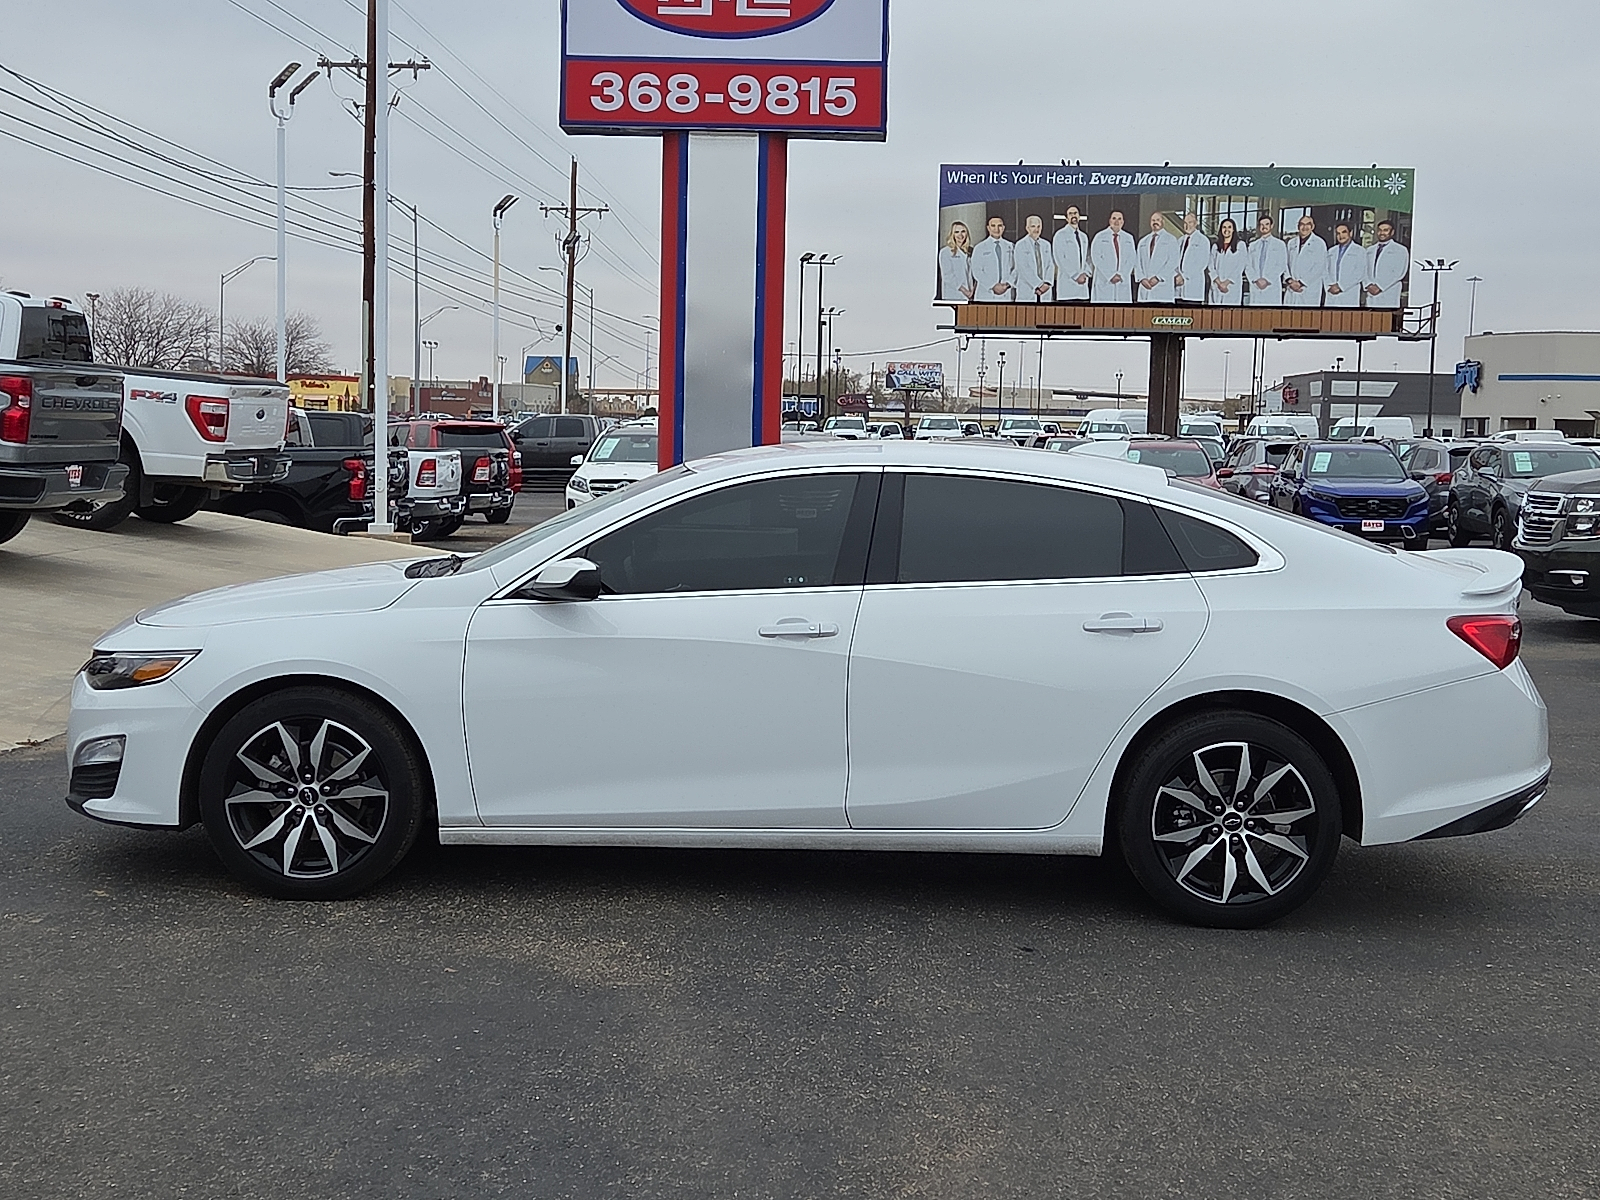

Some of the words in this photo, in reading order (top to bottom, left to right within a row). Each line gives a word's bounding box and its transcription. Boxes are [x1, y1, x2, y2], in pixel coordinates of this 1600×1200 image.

[590, 71, 858, 117] 368-9815
[947, 170, 986, 184] When
[989, 170, 1008, 184] It's
[1011, 171, 1043, 185] Your
[1046, 171, 1087, 187] Heart,
[1088, 172, 1132, 188] Every
[1132, 172, 1194, 186] Moment
[1194, 173, 1254, 187] Matters.
[1280, 174, 1381, 189] CovenantHealth
[1154, 317, 1190, 325] LAMAR
[896, 369, 918, 377] CALL
[130, 389, 178, 402] FX4
